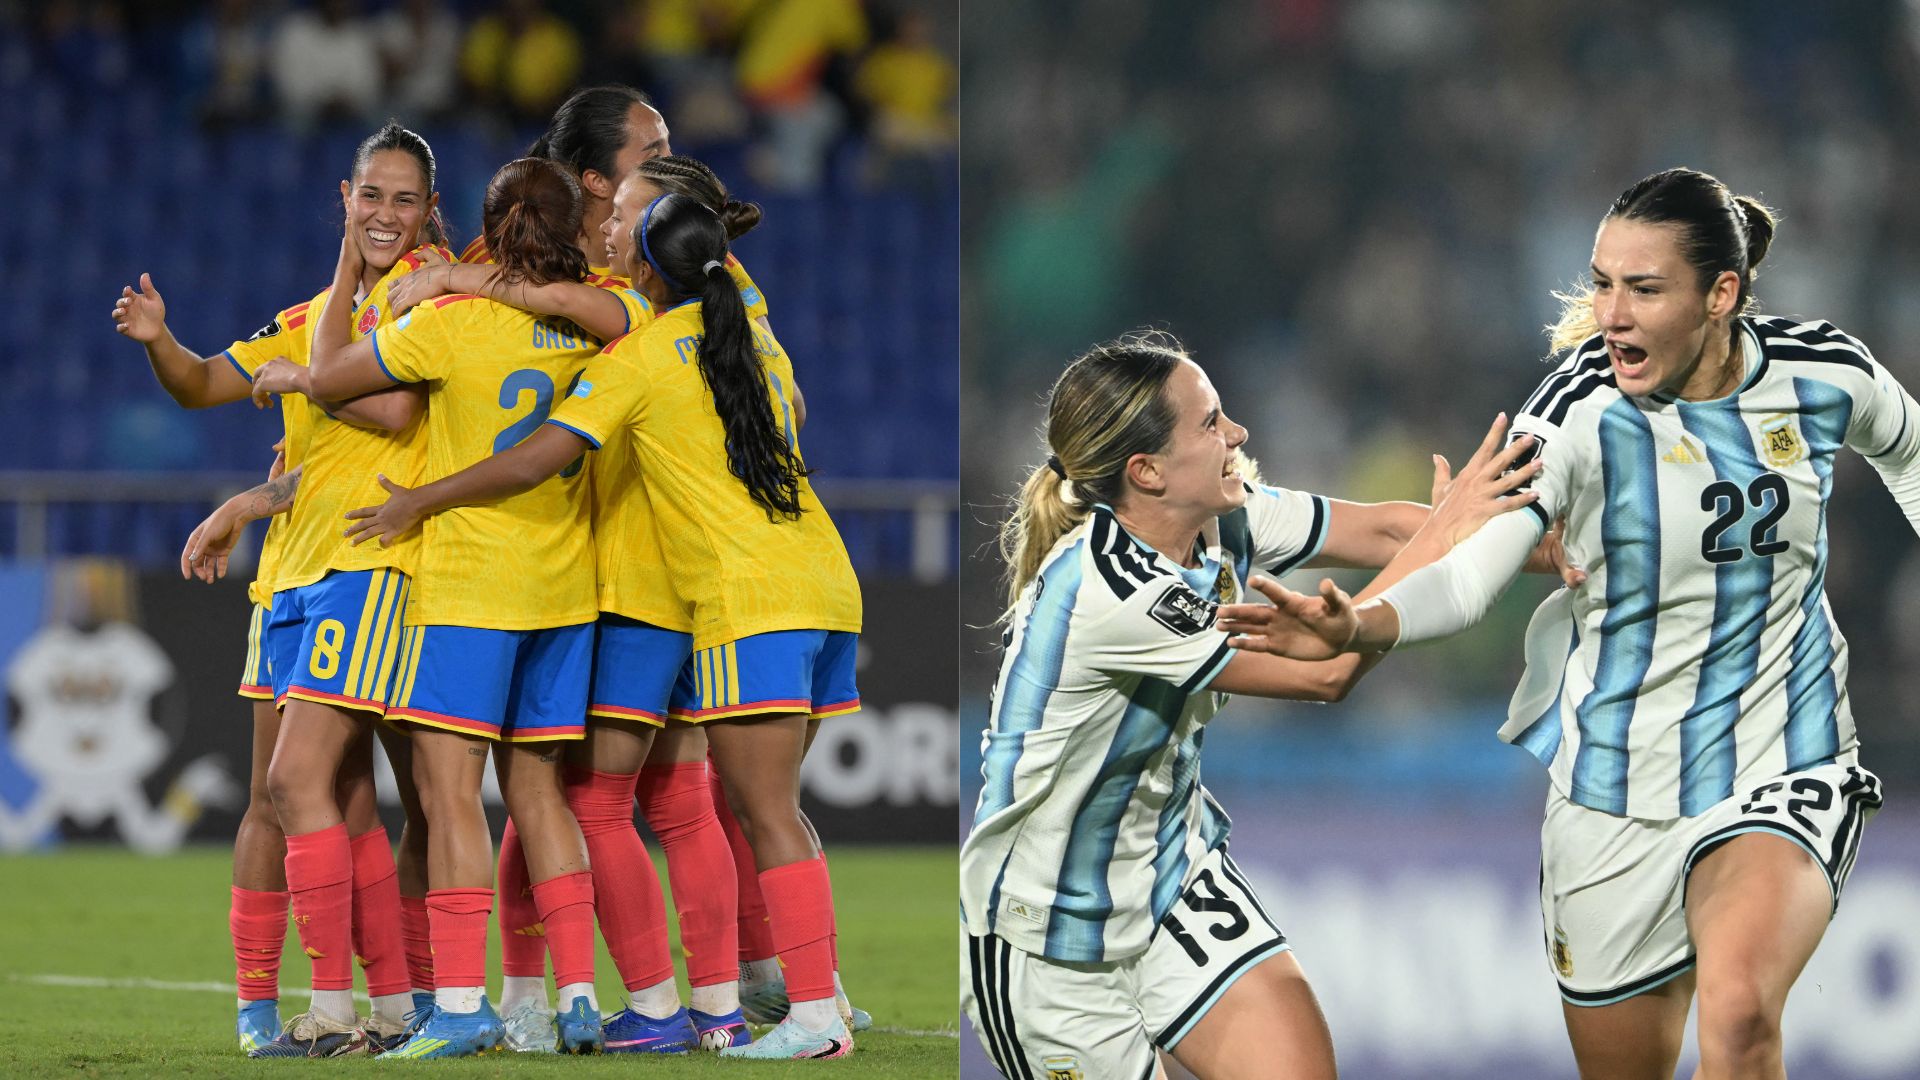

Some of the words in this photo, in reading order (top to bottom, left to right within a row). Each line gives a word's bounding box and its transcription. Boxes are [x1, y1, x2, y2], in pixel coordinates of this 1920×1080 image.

[1770, 427, 1794, 452] AFA
[1700, 473, 1791, 564] 22
[309, 618, 346, 680] 8
[1740, 777, 1834, 838] 22
[1161, 868, 1250, 968] 19
